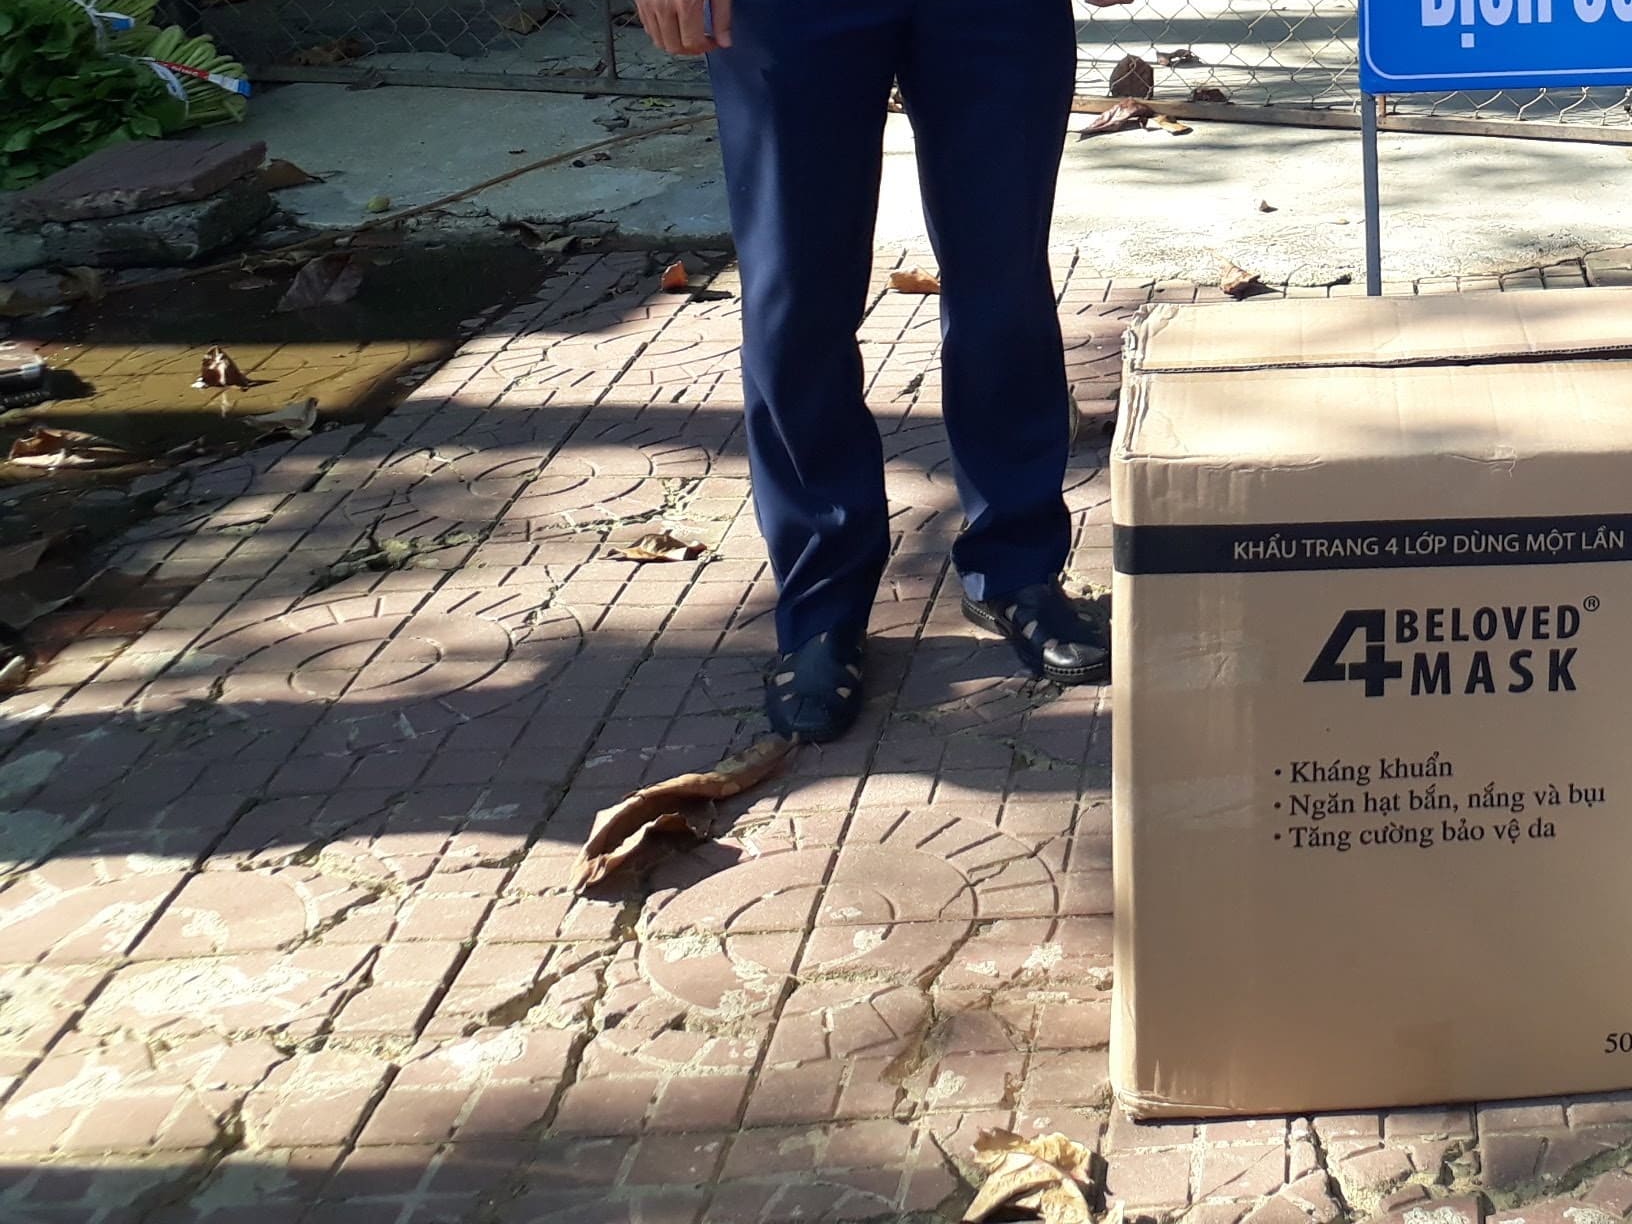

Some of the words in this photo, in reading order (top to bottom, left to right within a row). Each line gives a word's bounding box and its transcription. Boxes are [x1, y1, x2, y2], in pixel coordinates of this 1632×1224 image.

[1233, 533, 1297, 560] KHẨU
[1301, 536, 1379, 558] TRANG
[1384, 537, 1399, 556] 4
[1405, 532, 1447, 555] LỚP
[1454, 530, 1520, 553] DÙNG
[1526, 528, 1576, 557] MỘT
[1581, 525, 1625, 550] LẦN
[1396, 604, 1581, 643] BELOVED
[1411, 648, 1577, 696] MASK
[1289, 759, 1371, 785] Kháng
[1379, 751, 1453, 780] khuẩn
[1289, 793, 1355, 820] Ngăn
[1364, 791, 1401, 818] hạt
[1409, 783, 1459, 813] bắn,
[1467, 781, 1525, 813] nắng
[1534, 784, 1561, 806] và
[1289, 826, 1351, 851] Tăng
[1359, 823, 1434, 848] cường
[1441, 818, 1485, 842] bảo
[1494, 818, 1521, 844] vệ
[1527, 816, 1556, 839] da
